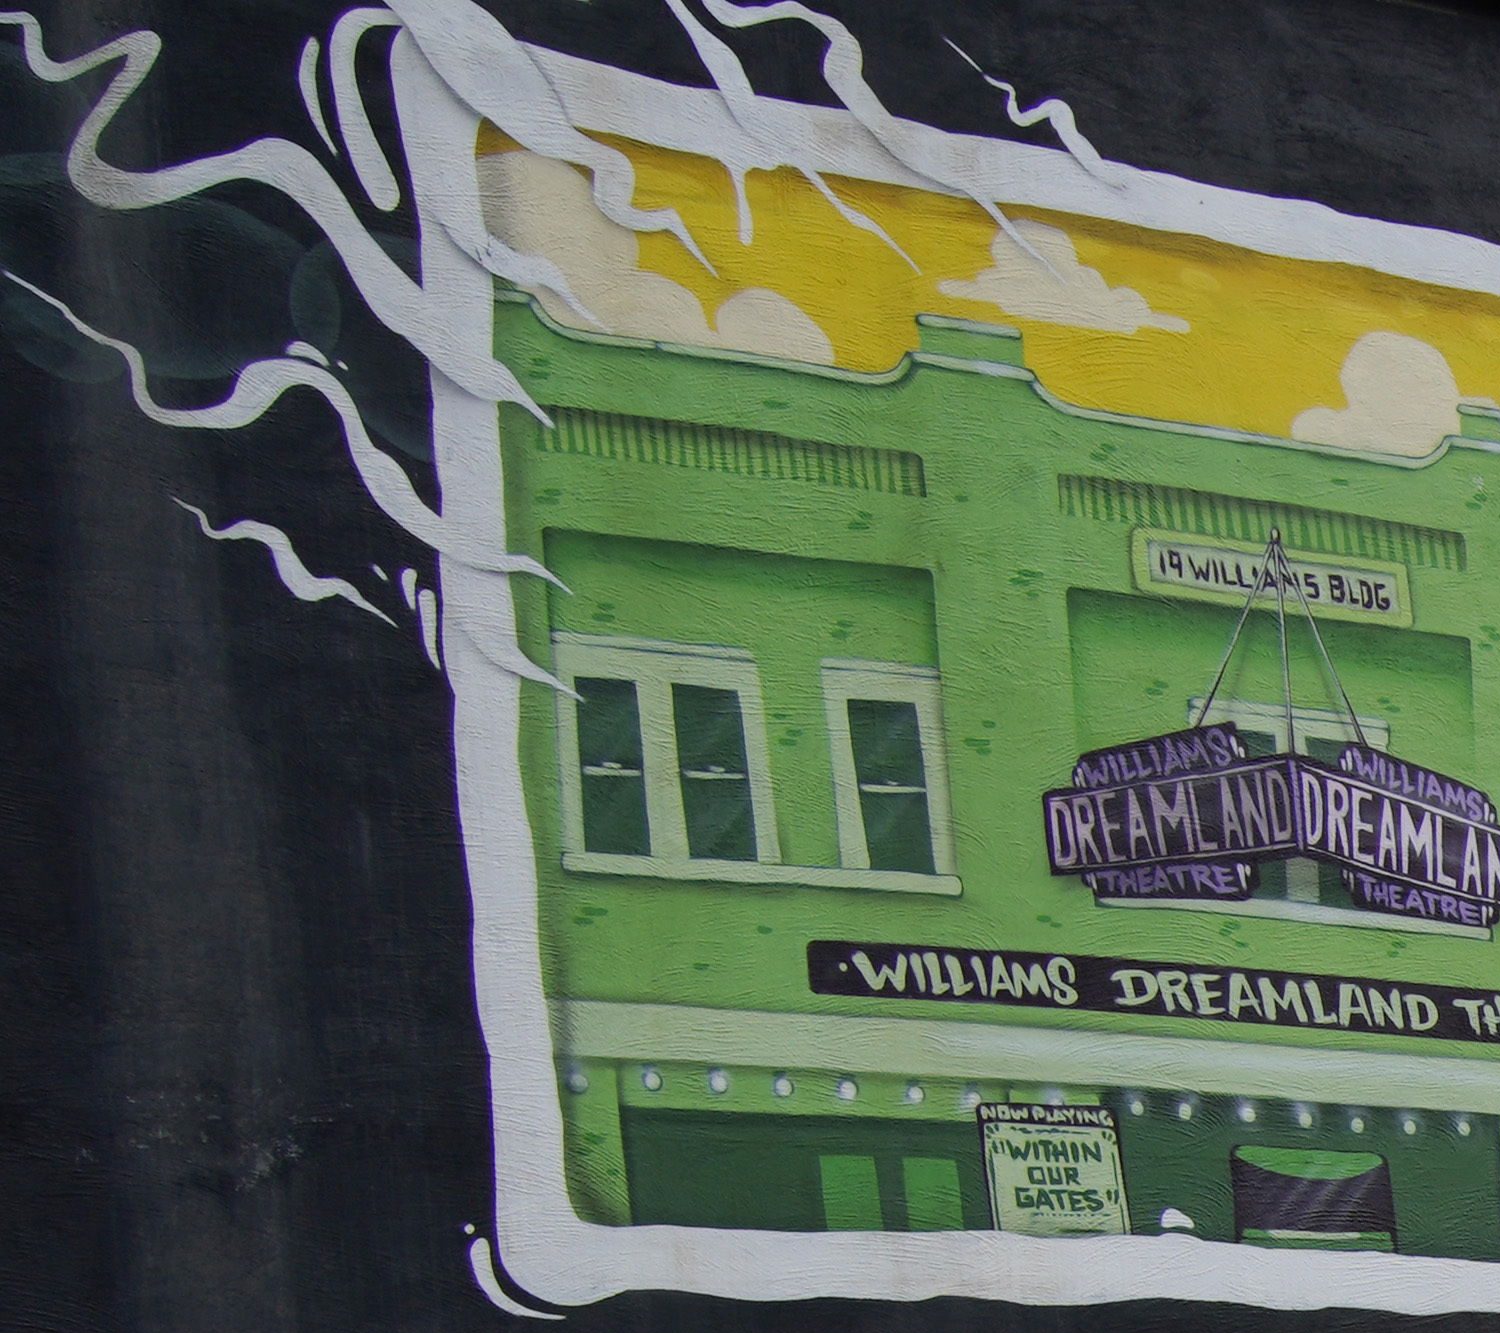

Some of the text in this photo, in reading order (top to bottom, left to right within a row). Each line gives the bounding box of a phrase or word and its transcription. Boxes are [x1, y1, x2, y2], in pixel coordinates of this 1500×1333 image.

[1188, 555, 1322, 600] WILLIAMS
[1328, 574, 1391, 611] BLDG
[1083, 727, 1231, 787] WILLIAMS
[1352, 746, 1484, 820] WILLIAMS
[1050, 769, 1293, 868] DREAMLAND
[1098, 862, 1238, 897] THEATRE
[1360, 874, 1482, 926] THEATRE
[852, 950, 1079, 1006] WILLIAMS
[1111, 967, 1439, 1033] DREAMLAND
[980, 1105, 1115, 1127] NOW PLAYING
[1027, 1166, 1081, 1186] OUR
